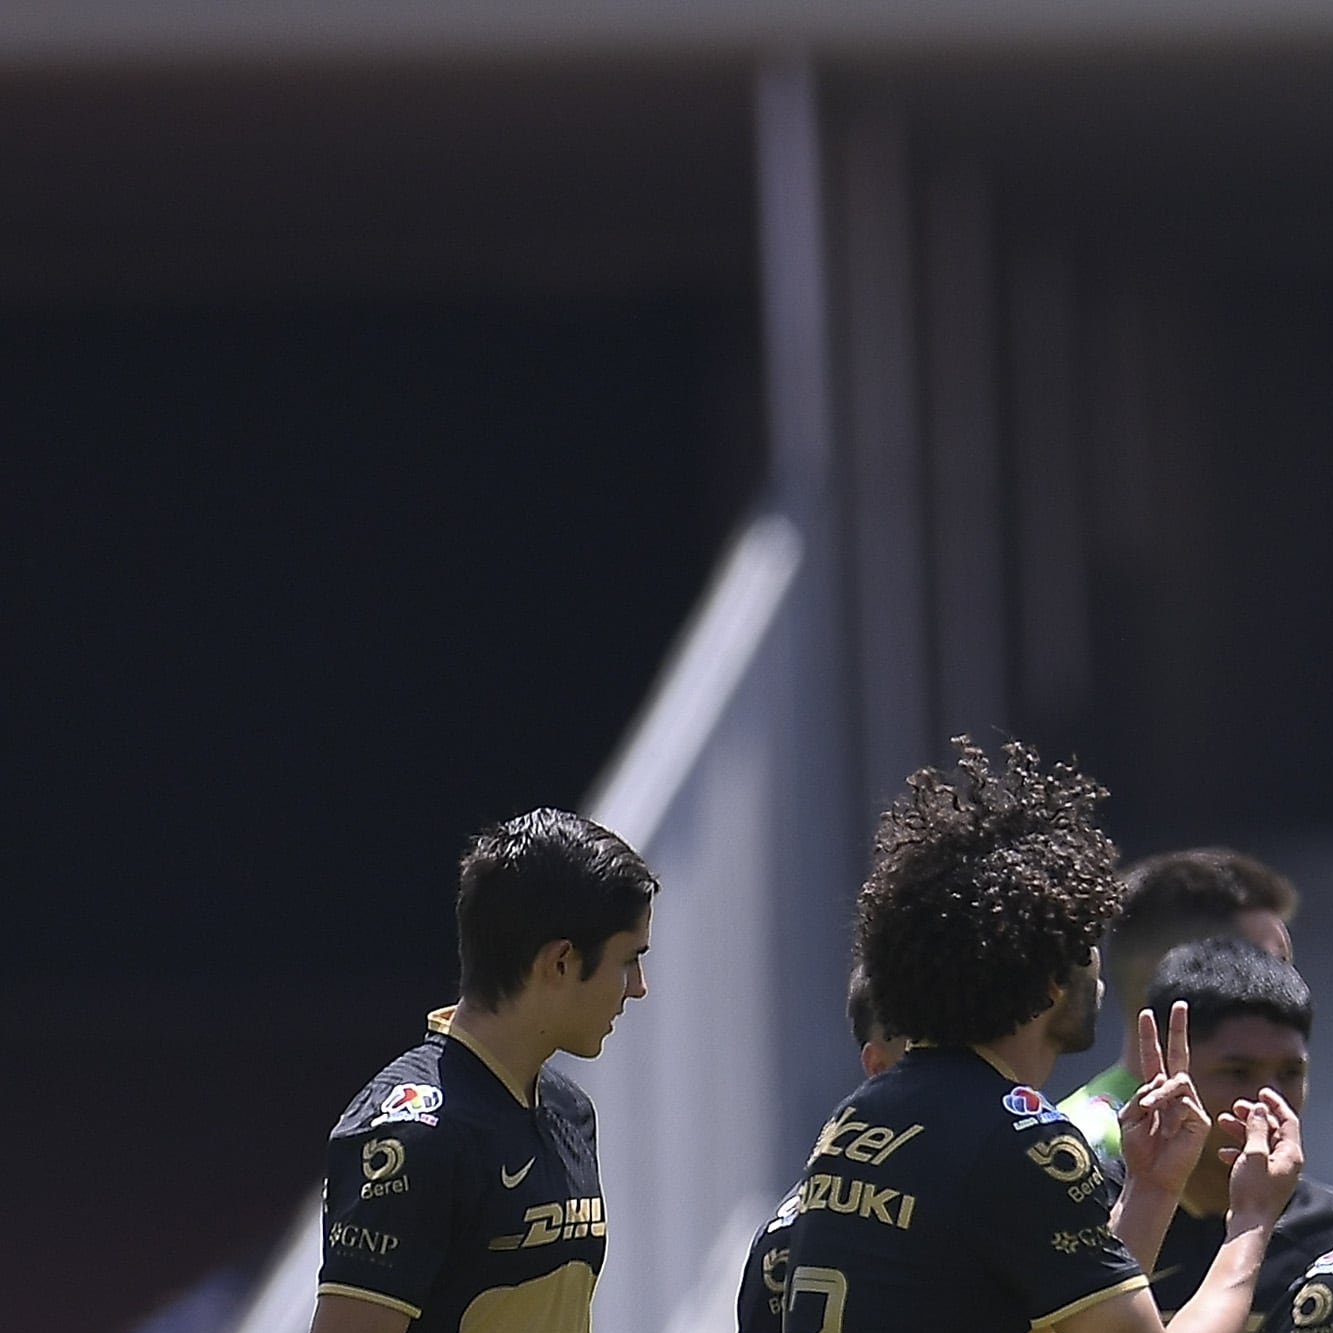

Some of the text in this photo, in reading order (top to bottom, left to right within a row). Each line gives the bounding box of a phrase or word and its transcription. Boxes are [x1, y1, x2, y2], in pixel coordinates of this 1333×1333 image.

[361, 1176, 410, 1200] Berel
[799, 1172, 916, 1230] UZUKI
[341, 1225, 399, 1255] GNP
